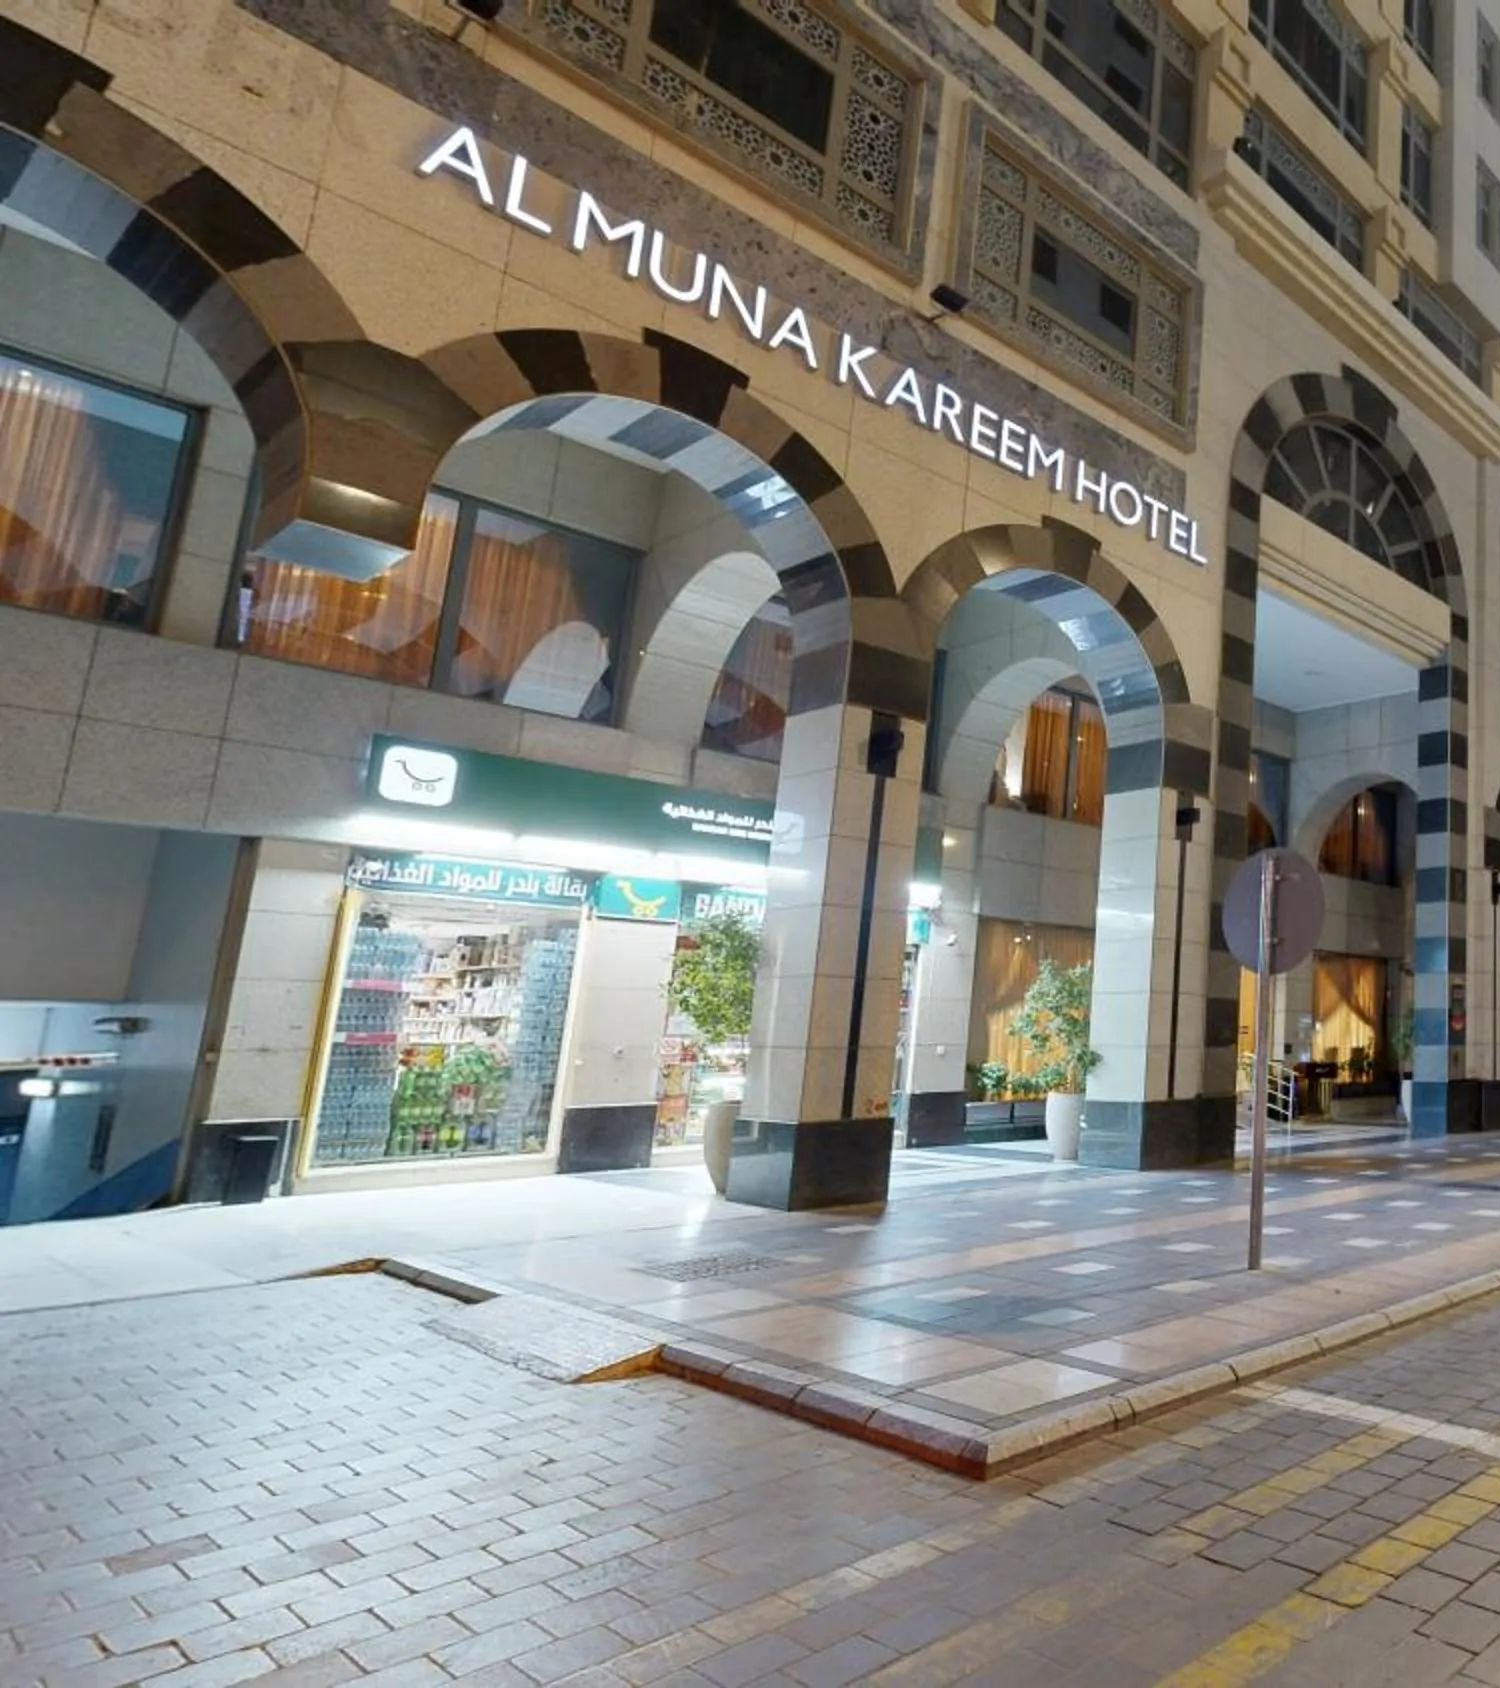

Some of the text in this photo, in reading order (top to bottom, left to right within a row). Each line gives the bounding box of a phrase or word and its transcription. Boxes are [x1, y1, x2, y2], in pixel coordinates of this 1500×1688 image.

[419, 126, 1208, 564] AL MUNA KAREEM HOTEL
[437, 866, 503, 894] للمواد
[505, 870, 540, 898] بندر
[544, 871, 588, 902] بقالة
